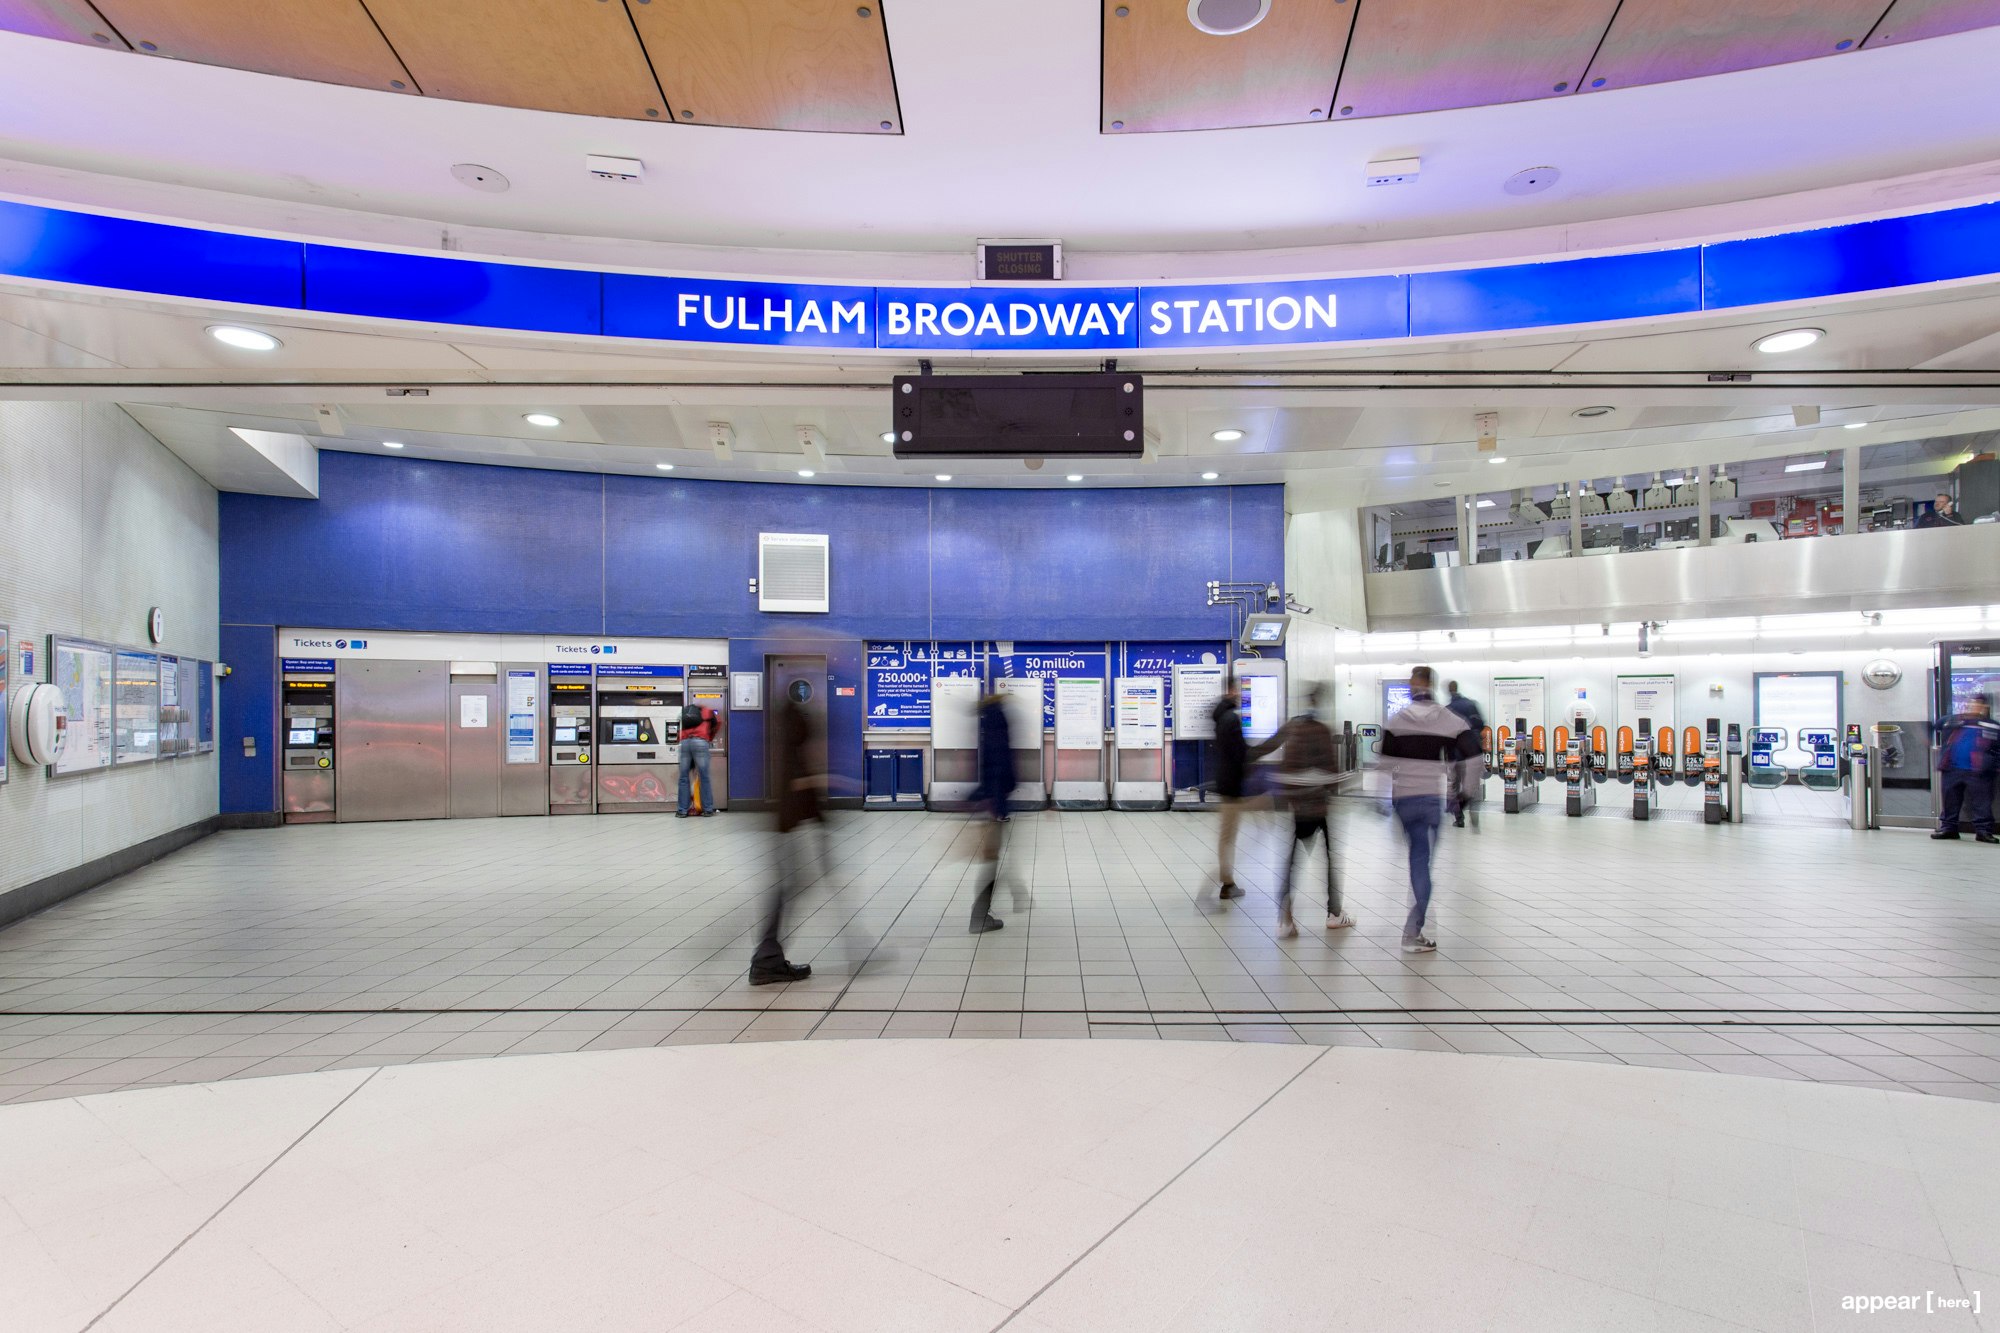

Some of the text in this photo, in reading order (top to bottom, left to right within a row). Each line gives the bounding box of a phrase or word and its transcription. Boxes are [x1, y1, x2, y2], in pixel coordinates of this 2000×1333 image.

[996, 252, 1042, 262] SHUTTER
[998, 263, 1042, 274] CLOSING
[678, 293, 1337, 337] FULHAM BROADWAY STATION
[294, 639, 332, 647] Tickets
[556, 645, 588, 653] Tickets
[1025, 658, 1085, 669] 50 million
[1133, 659, 1174, 669] 477,714
[877, 672, 928, 683] 250,000+
[1025, 670, 1058, 678] years
[1533, 753, 1545, 763] NO
[1593, 755, 1606, 766] NO
[1660, 757, 1673, 767] NO
